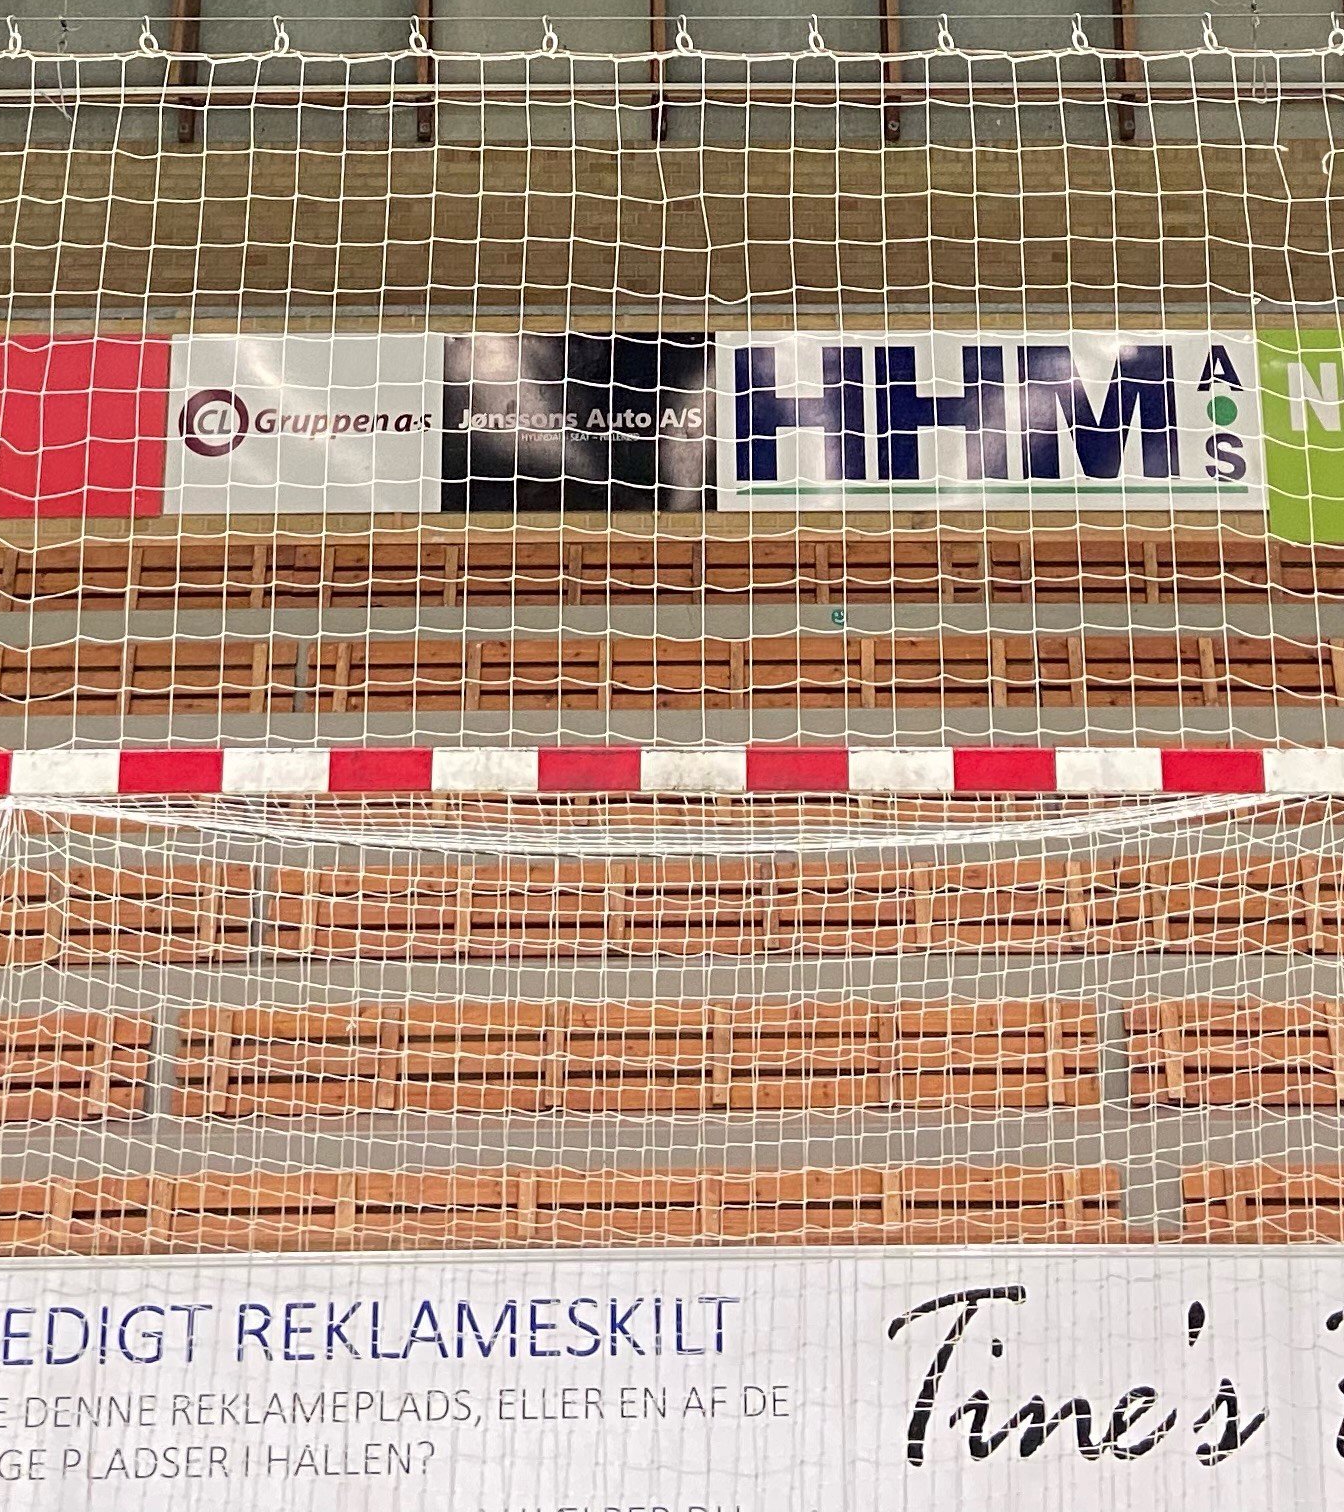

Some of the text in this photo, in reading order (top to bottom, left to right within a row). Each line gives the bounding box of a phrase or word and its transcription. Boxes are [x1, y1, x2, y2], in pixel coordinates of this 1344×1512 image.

[254, 408, 390, 439] Gruppen
[458, 408, 703, 429] Jønssons Auto A/S
[734, 344, 1181, 481] HHM
[236, 1295, 740, 1363] REKLAMESKILT
[888, 1285, 1269, 1468] Tine's
[24, 1392, 156, 1430] DENNE
[171, 1389, 483, 1427] REKLAMEPLADS,
[498, 1387, 605, 1423] ELLER
[619, 1386, 668, 1421] EN
[682, 1385, 729, 1420] AF
[742, 1384, 790, 1419] DE
[61, 1445, 228, 1481] PLADSER
[266, 1440, 436, 1480] HALLEN?
